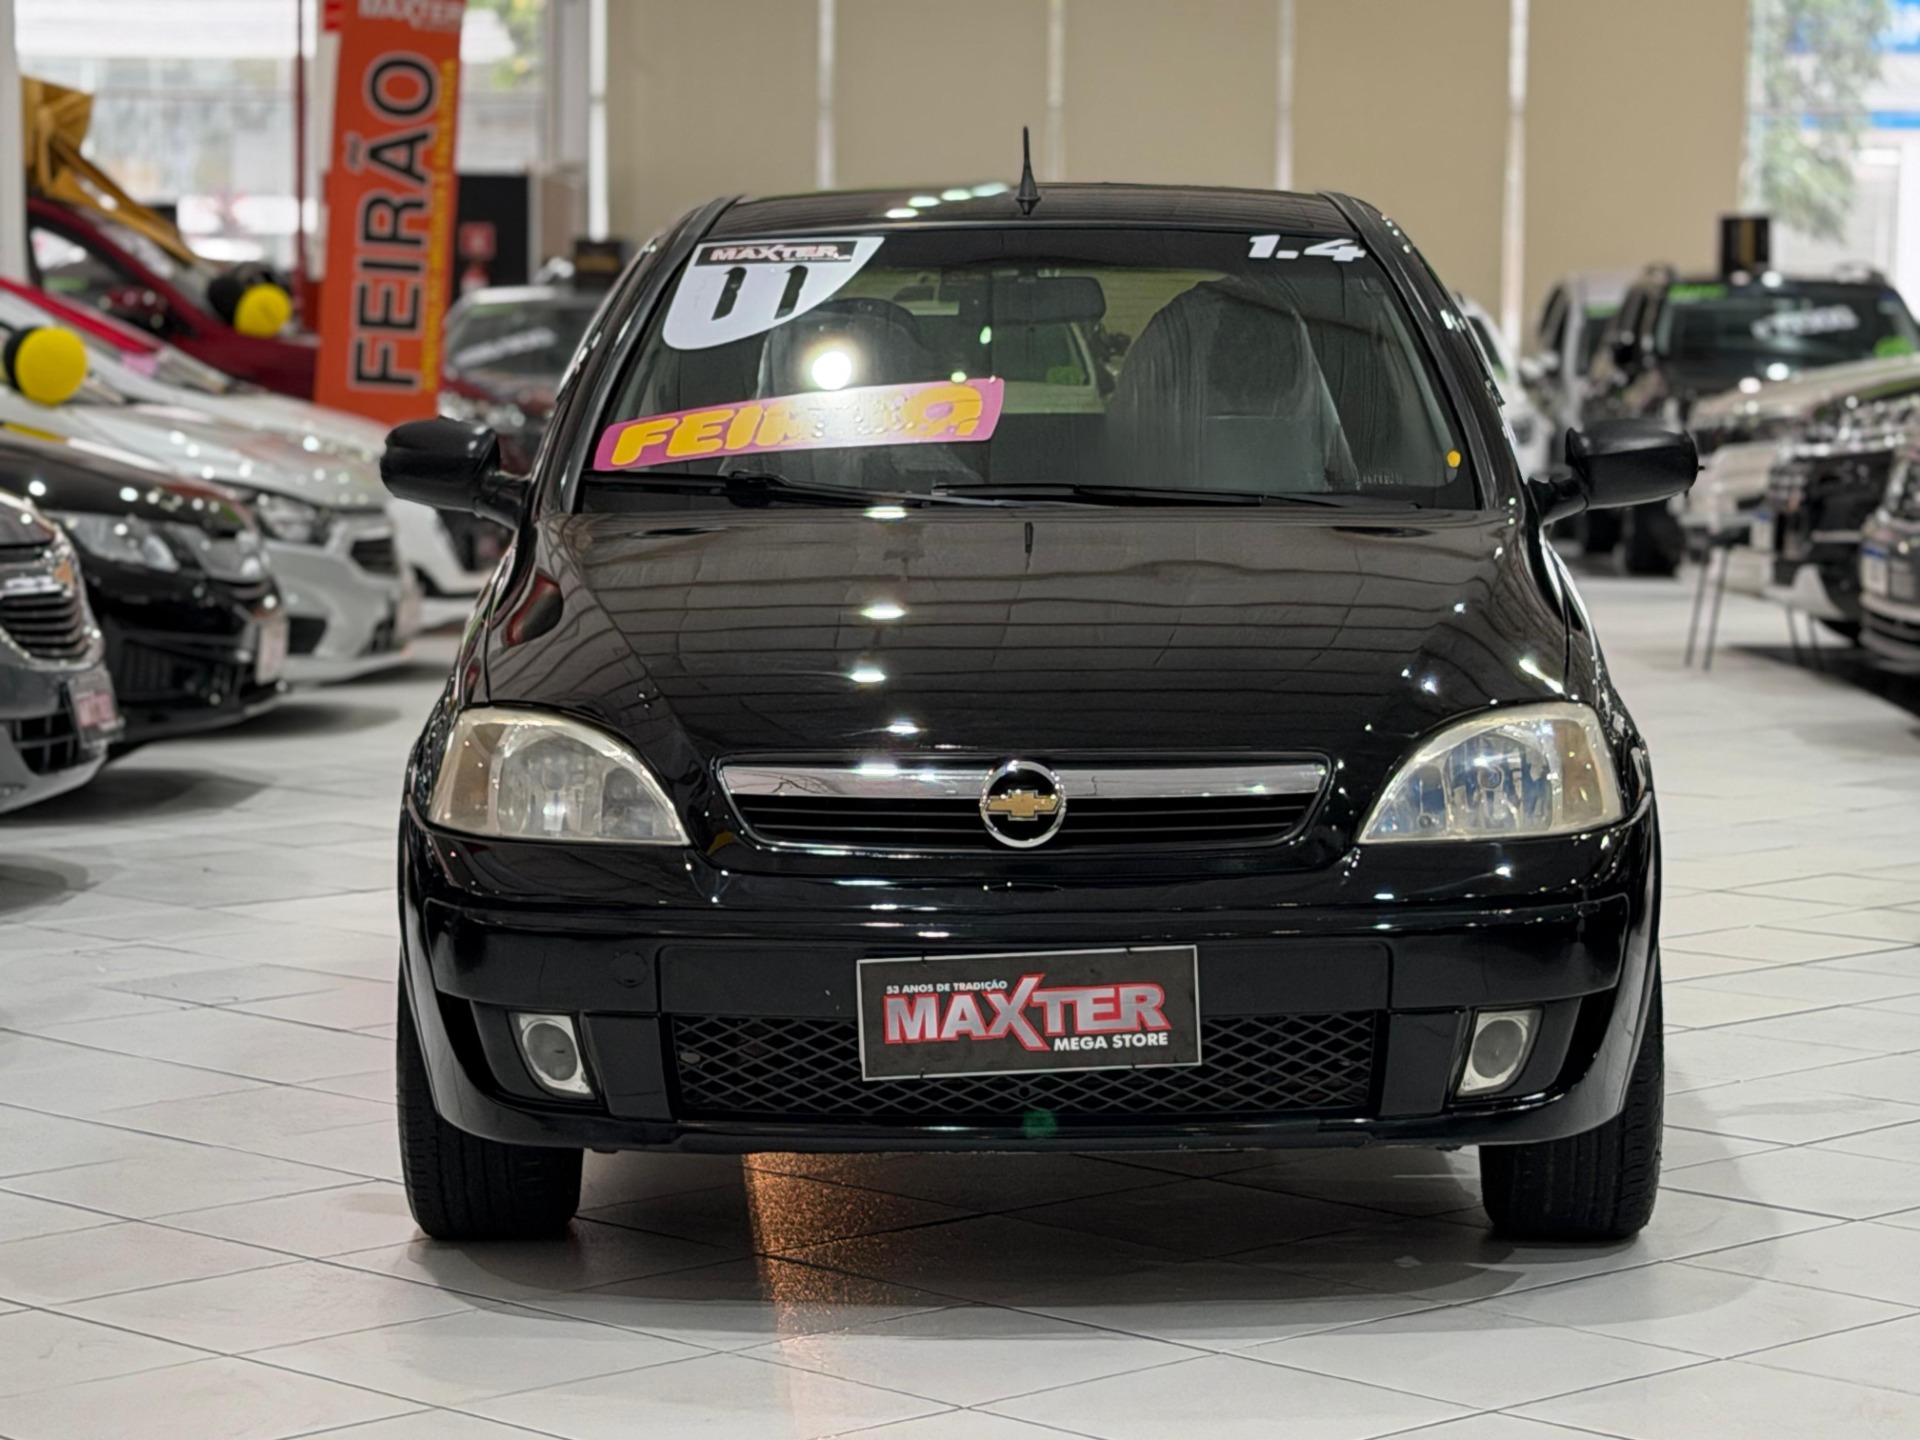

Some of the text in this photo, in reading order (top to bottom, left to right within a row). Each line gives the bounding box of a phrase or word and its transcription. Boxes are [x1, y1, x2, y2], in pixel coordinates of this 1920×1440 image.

[347, 52, 440, 391] FEIRÃO
[710, 244, 839, 261] MAXTER
[1248, 234, 1367, 262] 1.4
[711, 265, 809, 320] 11
[886, 979, 1008, 994] 53 ANOS DE TRADIÇÃO
[884, 973, 1172, 1051] MAXTER
[1054, 1032, 1169, 1052] MEGA STORE
